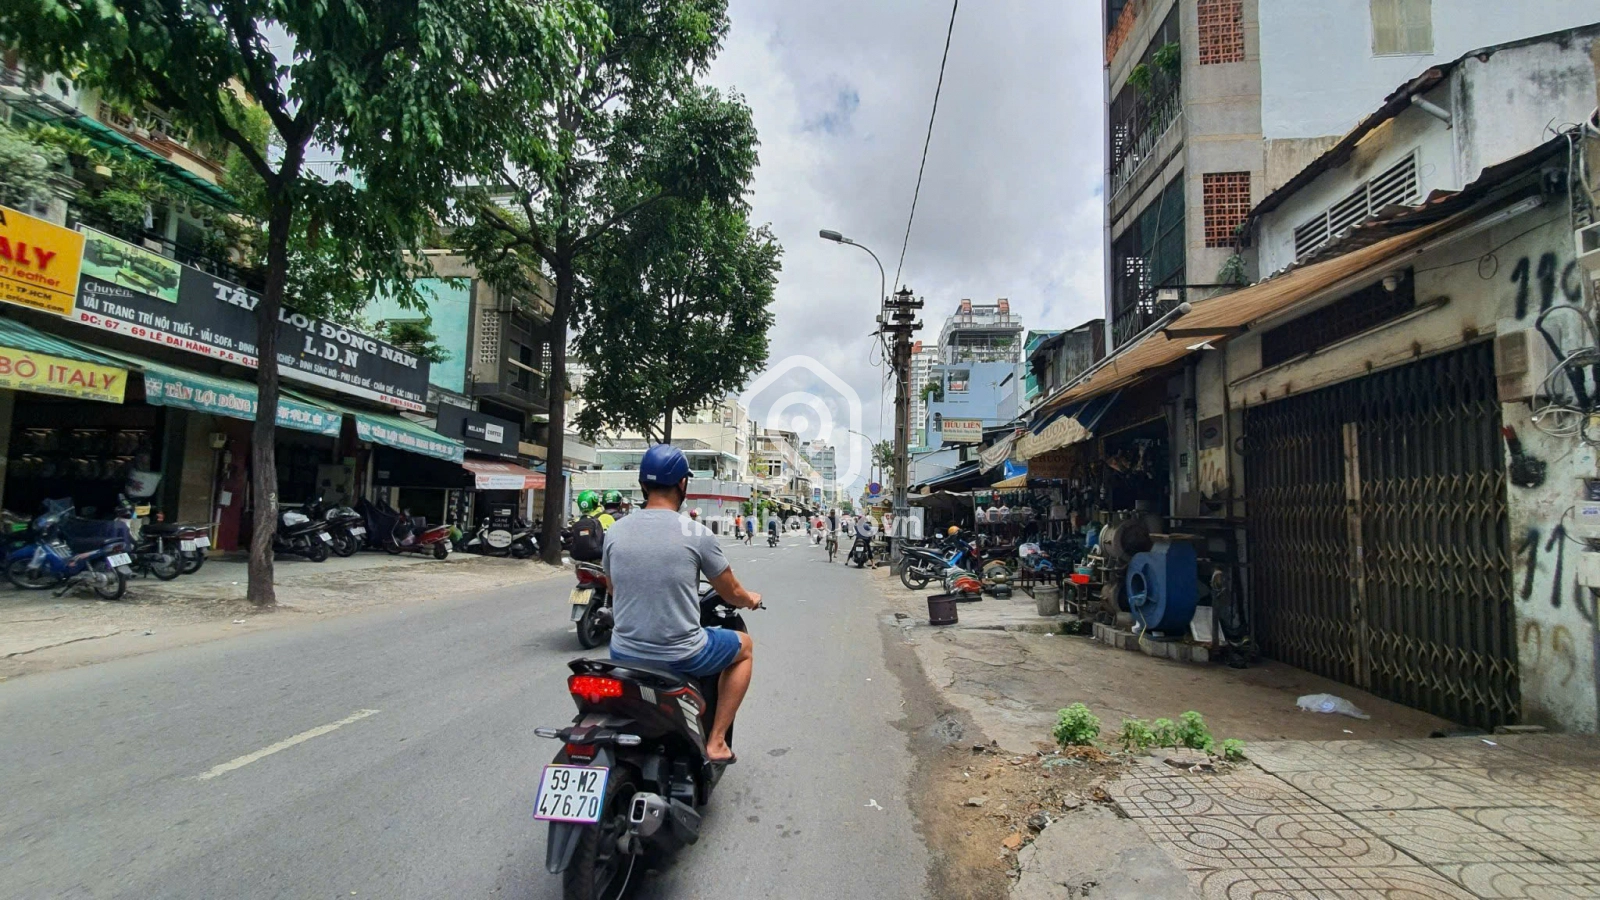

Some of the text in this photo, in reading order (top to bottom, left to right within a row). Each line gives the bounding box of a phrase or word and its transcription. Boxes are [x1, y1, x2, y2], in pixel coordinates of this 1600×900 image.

[81, 312, 101, 326] ĐC:
[105, 319, 120, 330] 67
[131, 327, 146, 337] 69
[150, 331, 163, 342] LÊ
[185, 340, 211, 354] HÀNH
[219, 350, 234, 361] P.6
[83, 293, 99, 310] VẢI
[103, 301, 135, 320] TRANG
[138, 311, 155, 326] TRÍ
[155, 315, 170, 332] NỘI
[172, 321, 194, 337] THẤT
[201, 327, 213, 343] VẢI
[214, 333, 232, 349] SOFA
[303, 335, 358, 369] L.D.N
[320, 321, 377, 355] ĐÔNG
[381, 346, 418, 370] NAM
[0, 354, 36, 378] BÒ
[48, 364, 116, 390] ITALY
[165, 381, 193, 399] TÂN
[195, 388, 217, 407] LỢI
[218, 393, 250, 412] ĐÔNG
[550, 769, 598, 794] 59-M2
[539, 795, 599, 819] 476.70
